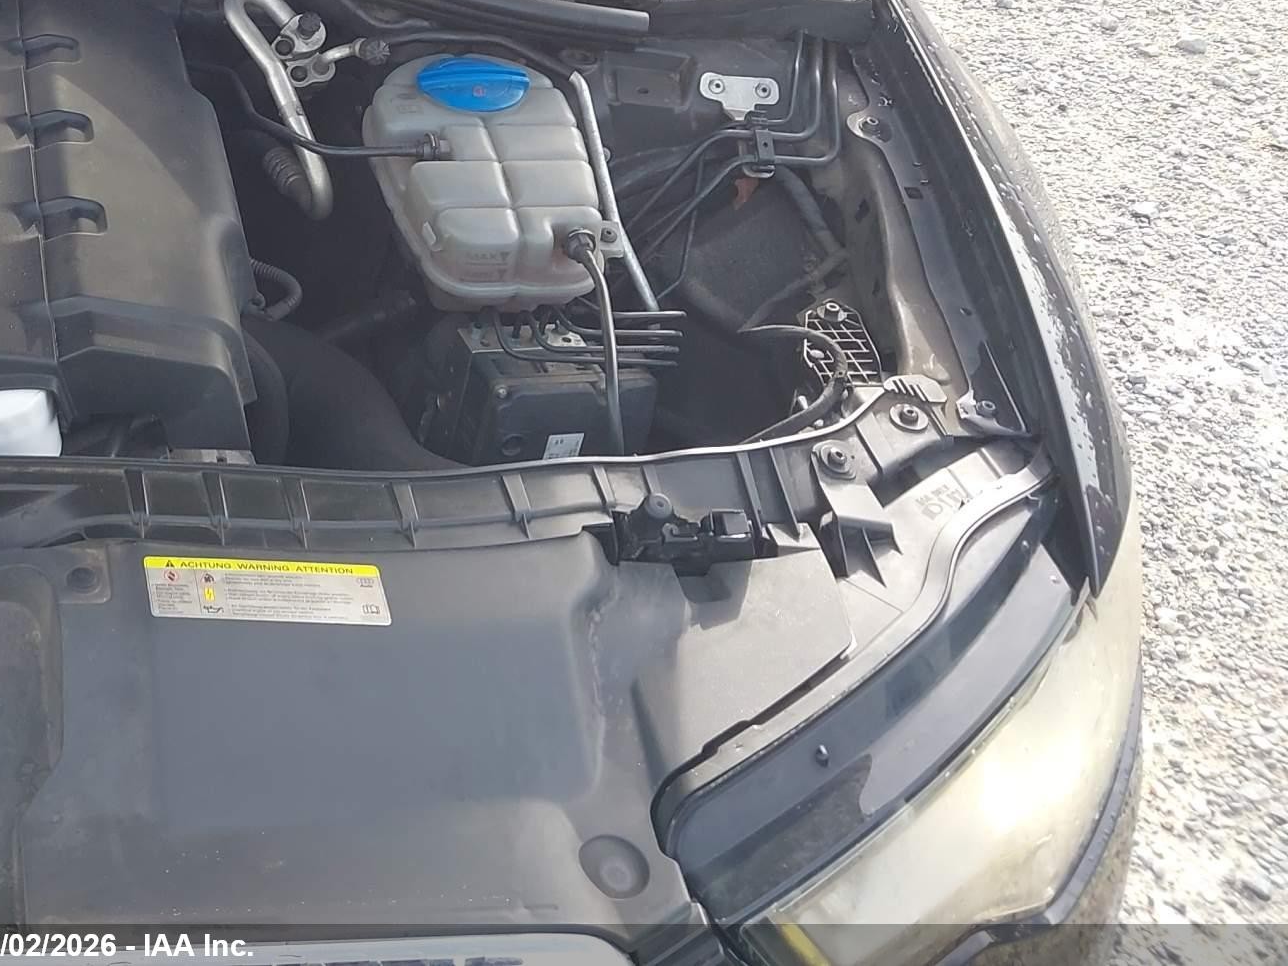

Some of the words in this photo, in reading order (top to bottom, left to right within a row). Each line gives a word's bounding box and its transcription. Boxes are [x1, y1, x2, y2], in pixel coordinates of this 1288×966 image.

[180, 560, 232, 570] ACHTUNG
[237, 562, 290, 572] WARNING
[295, 565, 354, 575] ATTENTION
